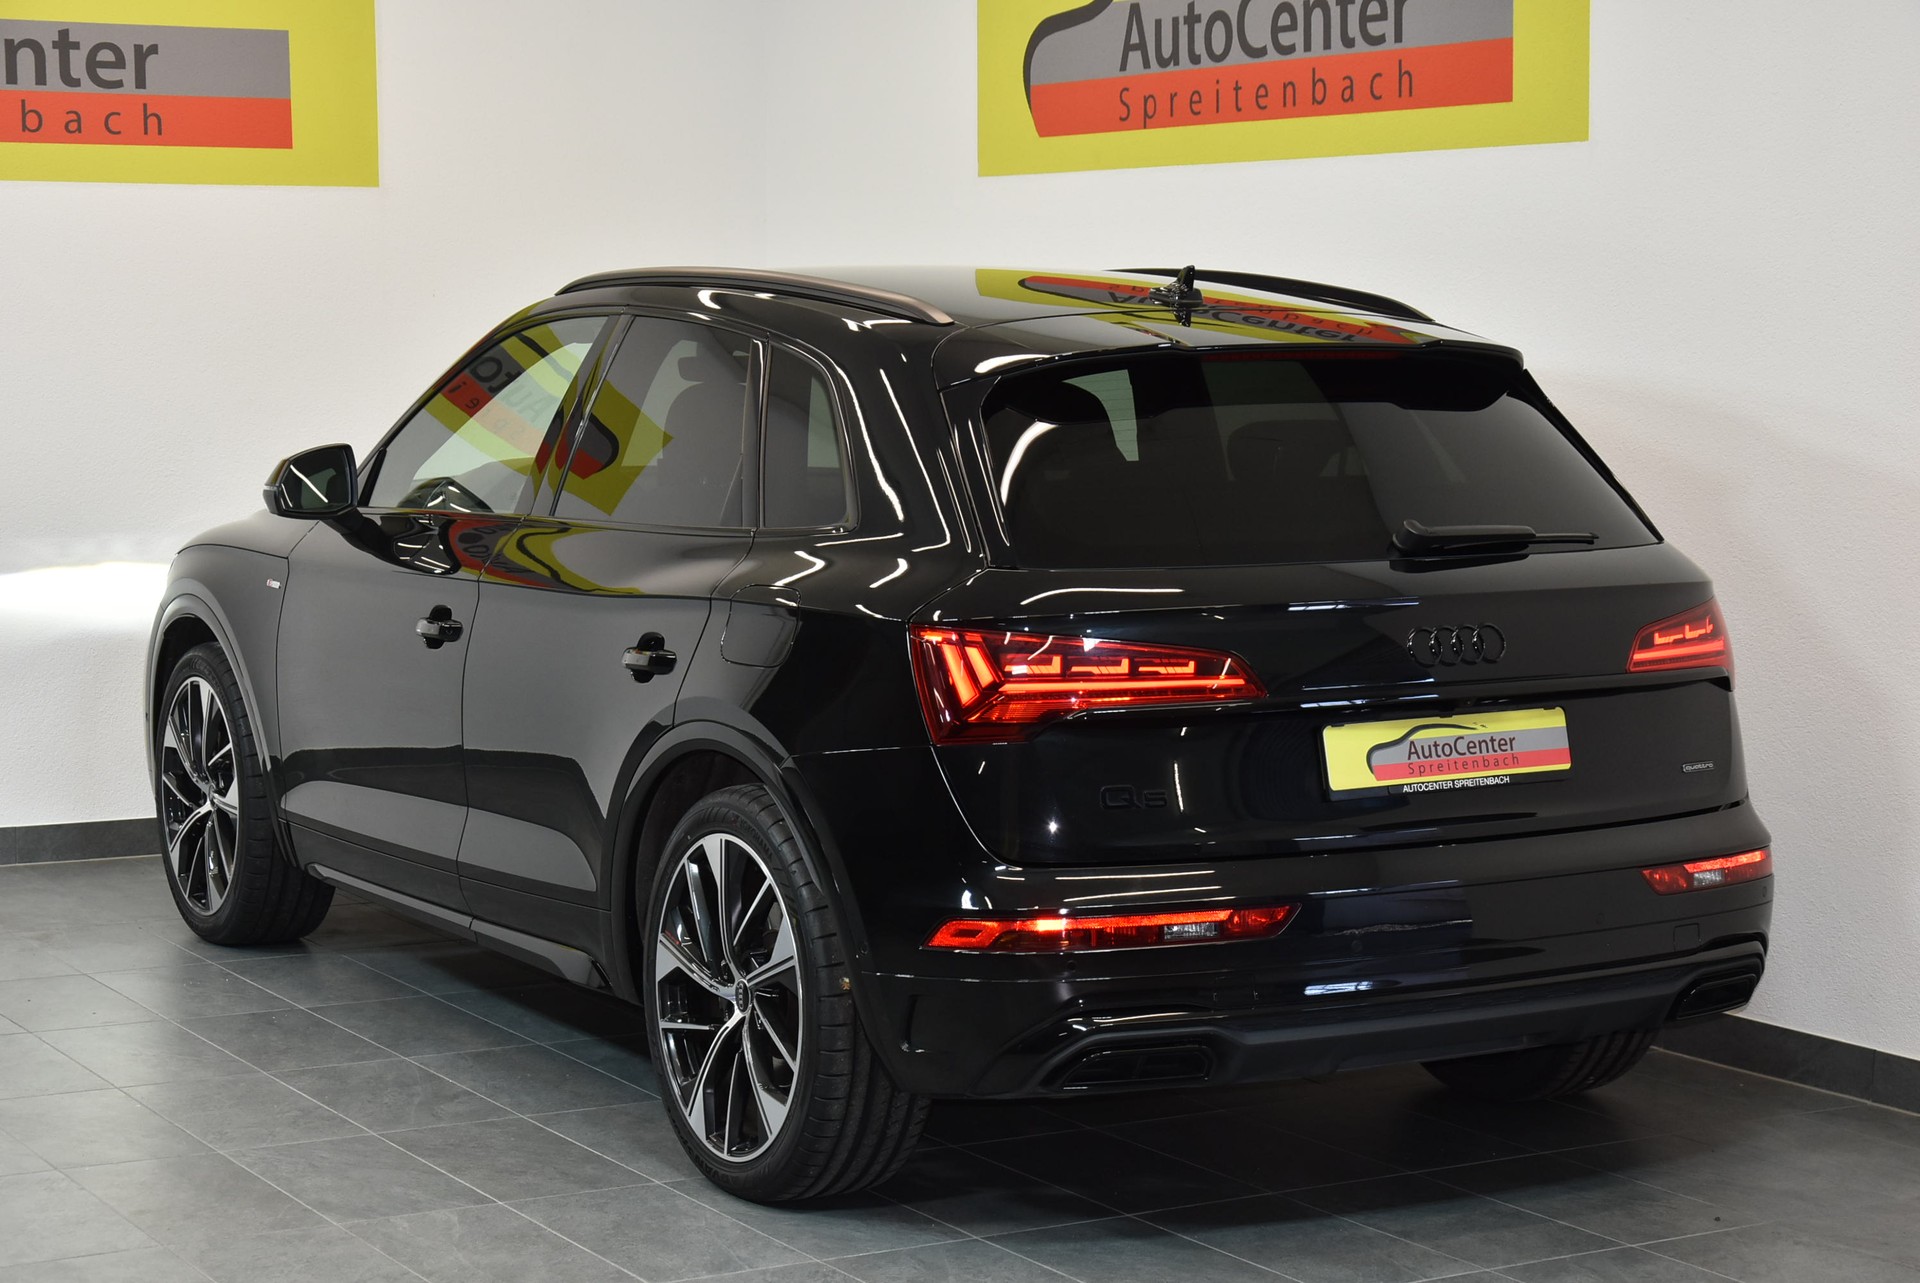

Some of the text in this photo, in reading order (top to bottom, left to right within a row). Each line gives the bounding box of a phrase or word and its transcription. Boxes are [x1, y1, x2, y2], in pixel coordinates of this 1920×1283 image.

[1119, 0, 1406, 72] AutoCenter
[1119, 59, 1413, 129] Spreitenbach
[20, 99, 163, 136] bach
[1407, 736, 1516, 761] AutoCenter
[1407, 752, 1519, 777] Spreitenbach
[1403, 775, 1510, 793] AUTOCENTER SPREITENBACH
[1101, 785, 1168, 809] Q5
